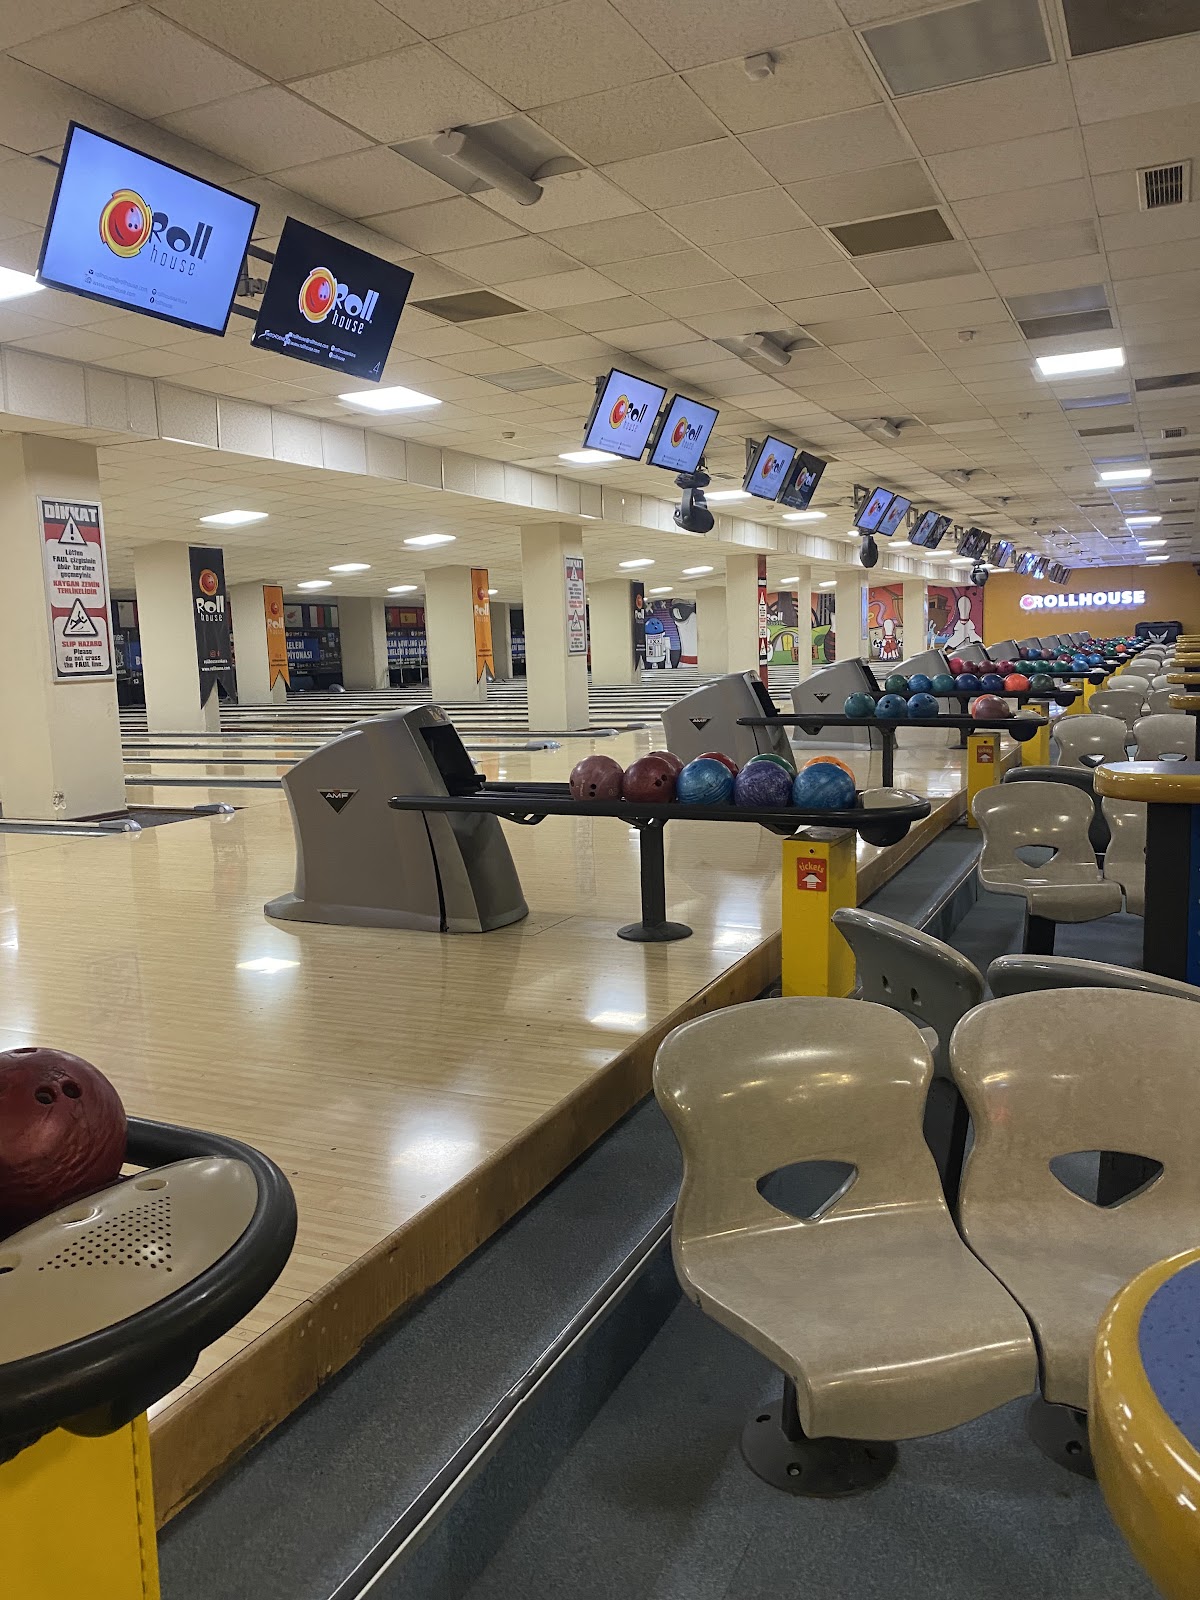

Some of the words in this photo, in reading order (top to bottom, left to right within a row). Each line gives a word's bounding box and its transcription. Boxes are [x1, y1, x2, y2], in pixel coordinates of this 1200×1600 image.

[149, 211, 213, 260] Roll
[150, 244, 196, 276] house
[331, 283, 379, 321] Roll
[332, 309, 364, 334] house
[44, 503, 97, 522] DİKKAT
[196, 596, 224, 613] Roll
[1033, 591, 1145, 608] ROLLHOUSE
[201, 613, 223, 621] house
[799, 862, 825, 873] tickets
